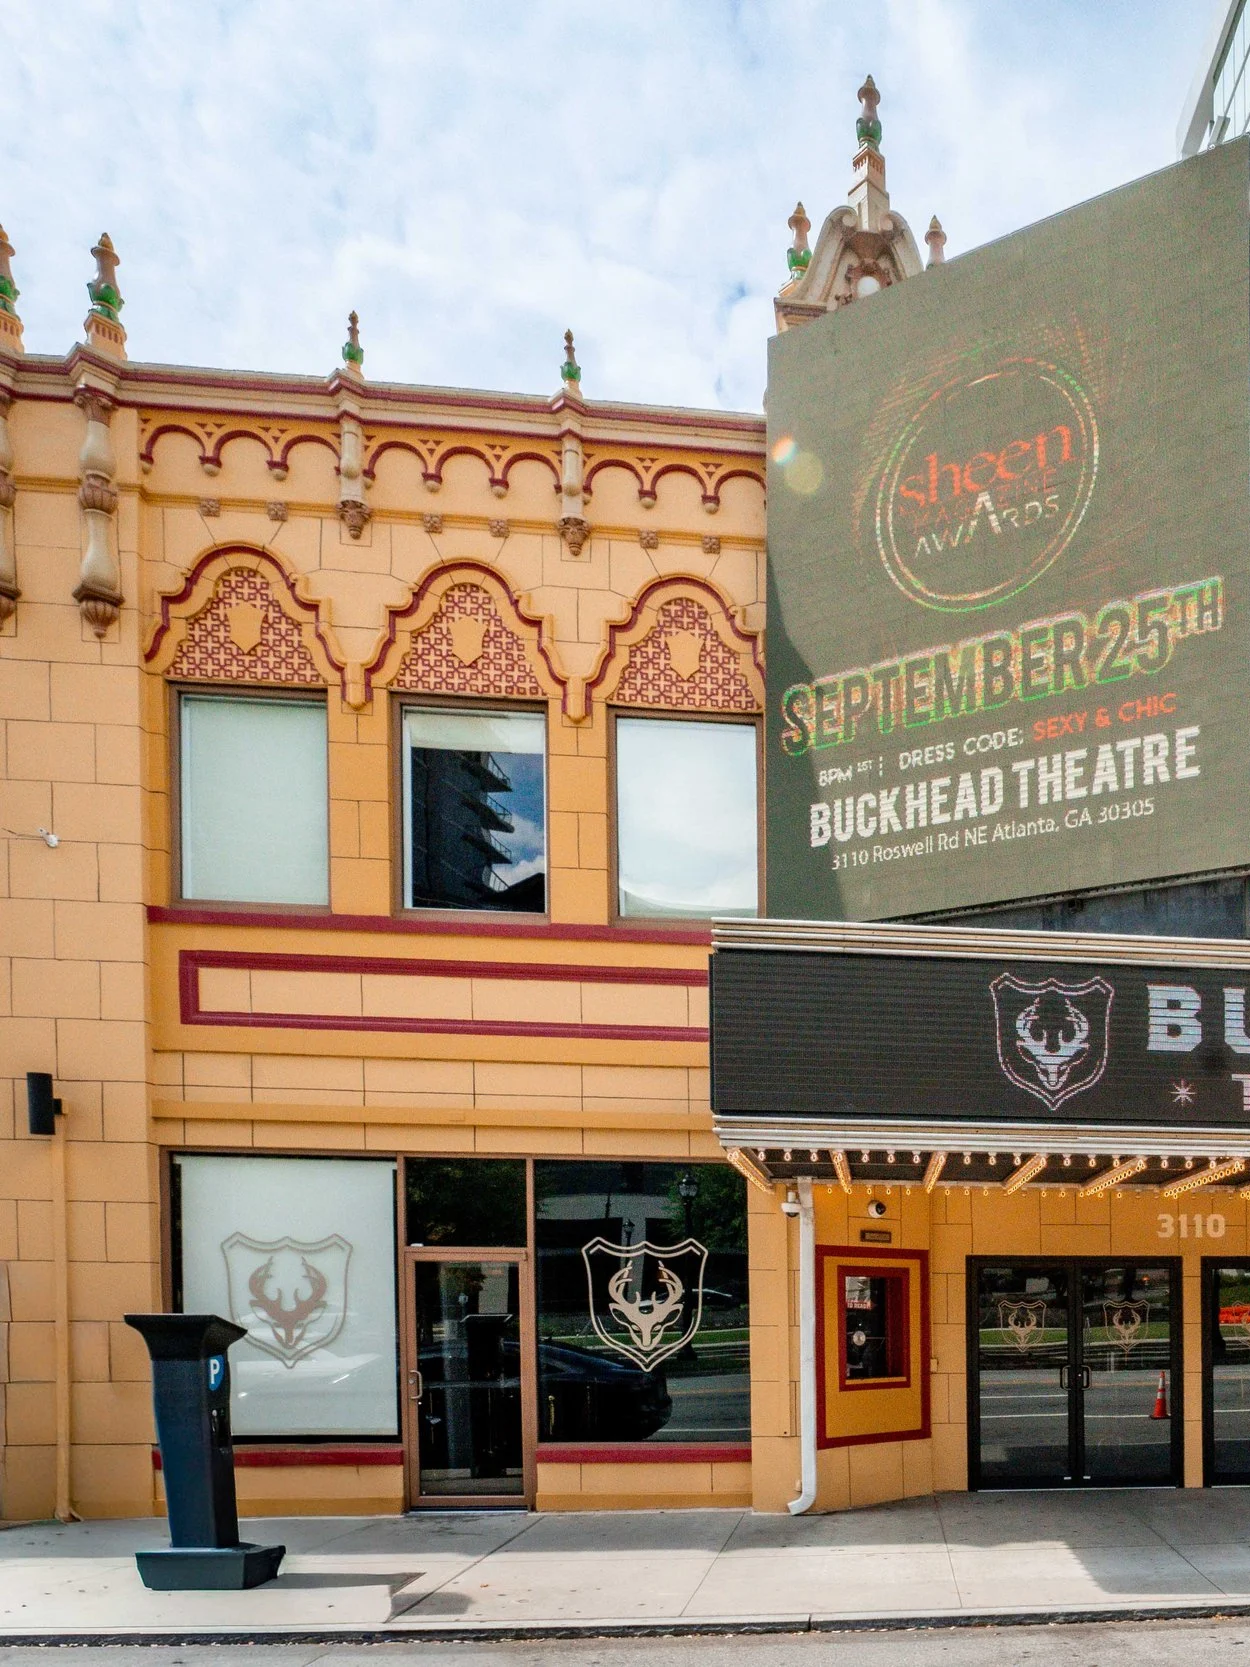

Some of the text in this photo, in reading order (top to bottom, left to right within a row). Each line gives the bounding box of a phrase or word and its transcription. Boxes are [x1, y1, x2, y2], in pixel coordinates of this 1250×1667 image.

[900, 425, 1075, 507] sheen
[914, 491, 1060, 558] AWARDS
[780, 576, 1224, 756] SEPTEMBER 25TH
[899, 742, 956, 770] DRESS
[1033, 711, 1087, 741] SEXY
[1095, 706, 1112, 728] &
[1118, 692, 1178, 722] CHIC
[810, 725, 1201, 848] BUCKHEAD THEATRE
[832, 798, 1155, 870] 3110 Roswell Rd NE Atlanta, GA 30305
[1157, 1213, 1226, 1239] 3110
[209, 1358, 220, 1385] P
